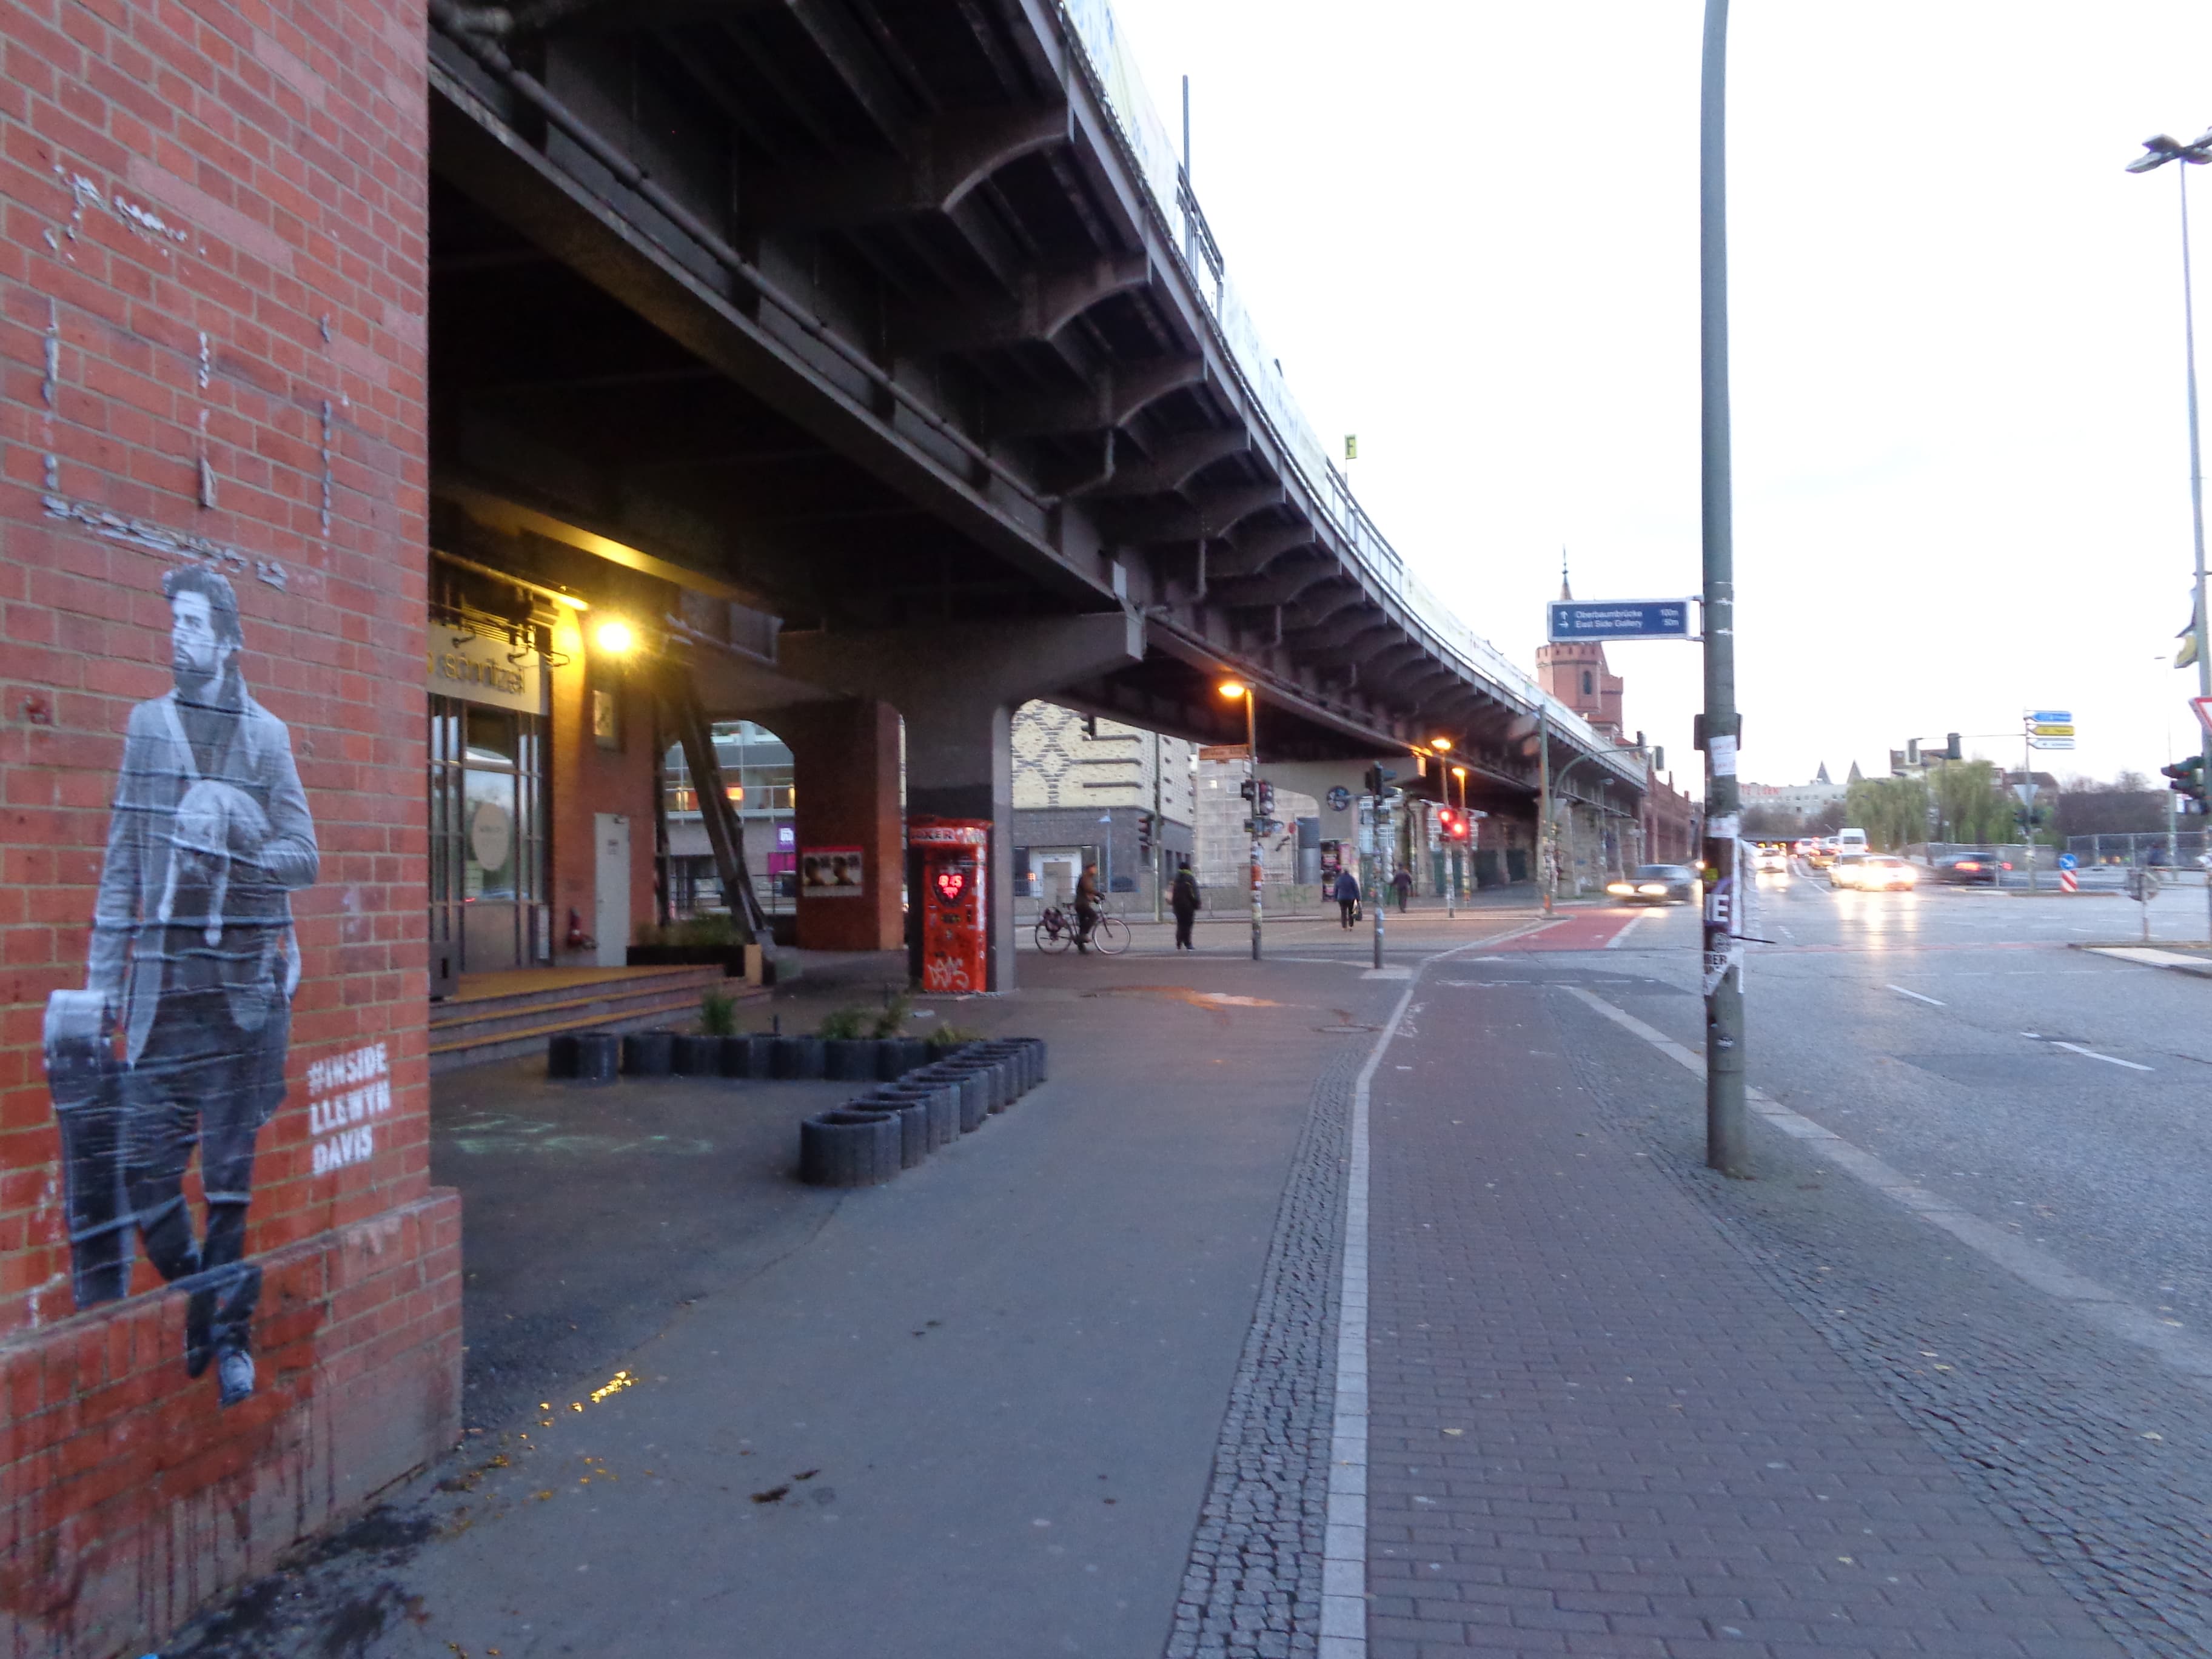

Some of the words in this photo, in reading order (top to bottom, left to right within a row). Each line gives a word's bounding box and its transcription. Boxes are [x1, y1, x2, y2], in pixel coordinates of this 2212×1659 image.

[1575, 609, 1643, 618] Oberbaumbrücke
[1615, 619, 1643, 628] Gallery
[307, 1042, 388, 1097] #INSIDE
[310, 1079, 391, 1136] LLEWYN
[312, 1124, 374, 1176] DAVIS
